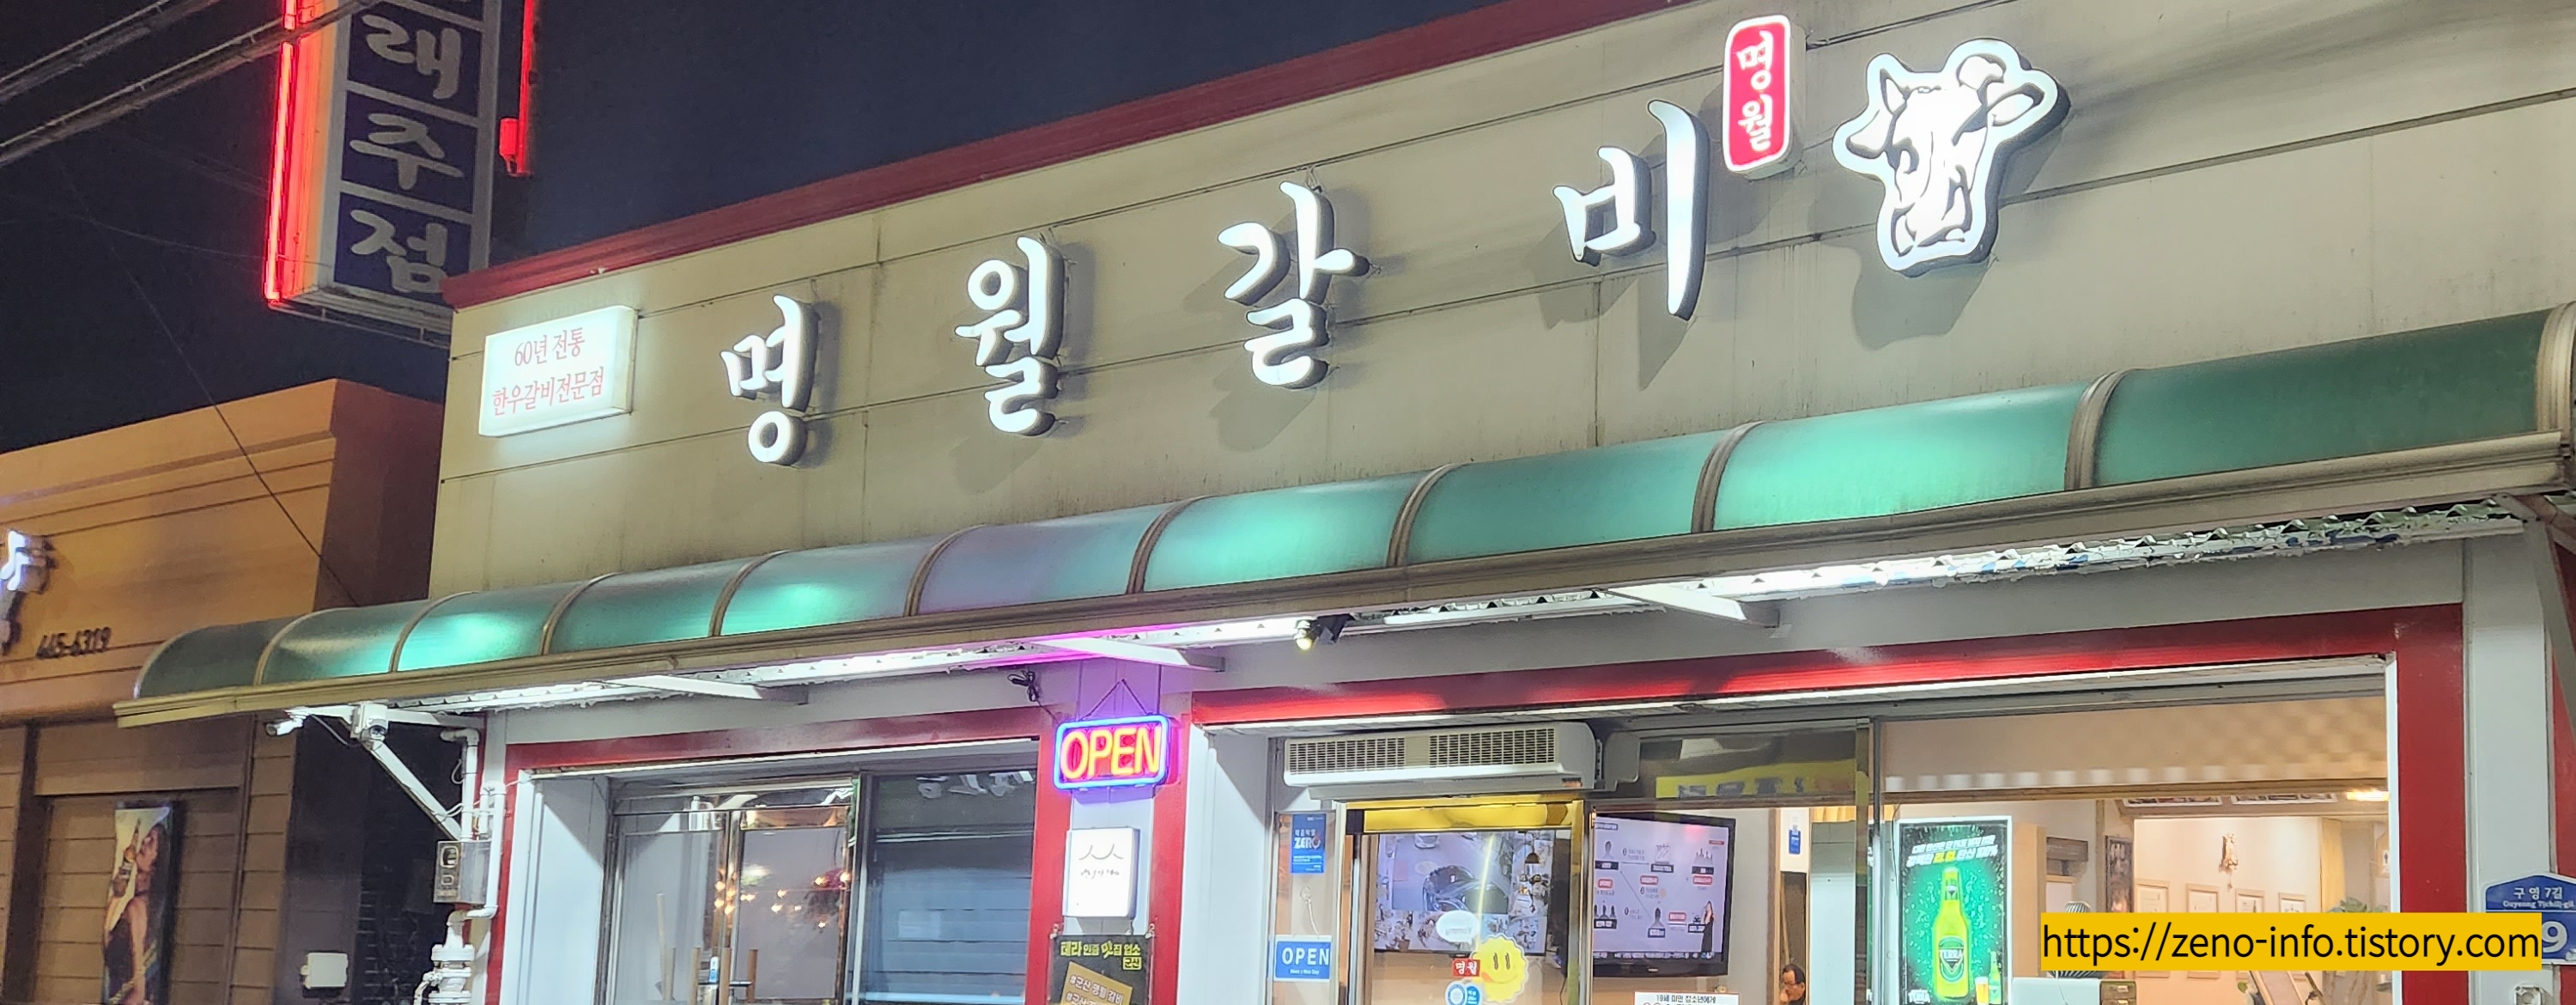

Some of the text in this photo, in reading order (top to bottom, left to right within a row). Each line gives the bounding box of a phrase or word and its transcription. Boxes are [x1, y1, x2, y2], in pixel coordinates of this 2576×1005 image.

[1736, 30, 1774, 151] 명월
[349, 0, 465, 293] 래주점
[720, 100, 1709, 466] 명월갈비
[514, 326, 586, 367] 60년 전통
[492, 365, 605, 417] 한우갈비전문점
[35, 626, 112, 660] 445-6319
[1060, 726, 1162, 779] OPEN
[2544, 886, 2563, 900] 7길
[1060, 941, 1082, 956] 테라
[1101, 940, 1122, 959] 맛집
[1123, 944, 1141, 956] 업소
[1124, 957, 1141, 969] 군산
[1282, 947, 1329, 965] OPEN
[1455, 960, 1478, 975] 명월
[1069, 974, 1092, 992] #군산
[1108, 990, 1123, 1005] 갈비
[1685, 995, 1716, 1003] 청소년에게
